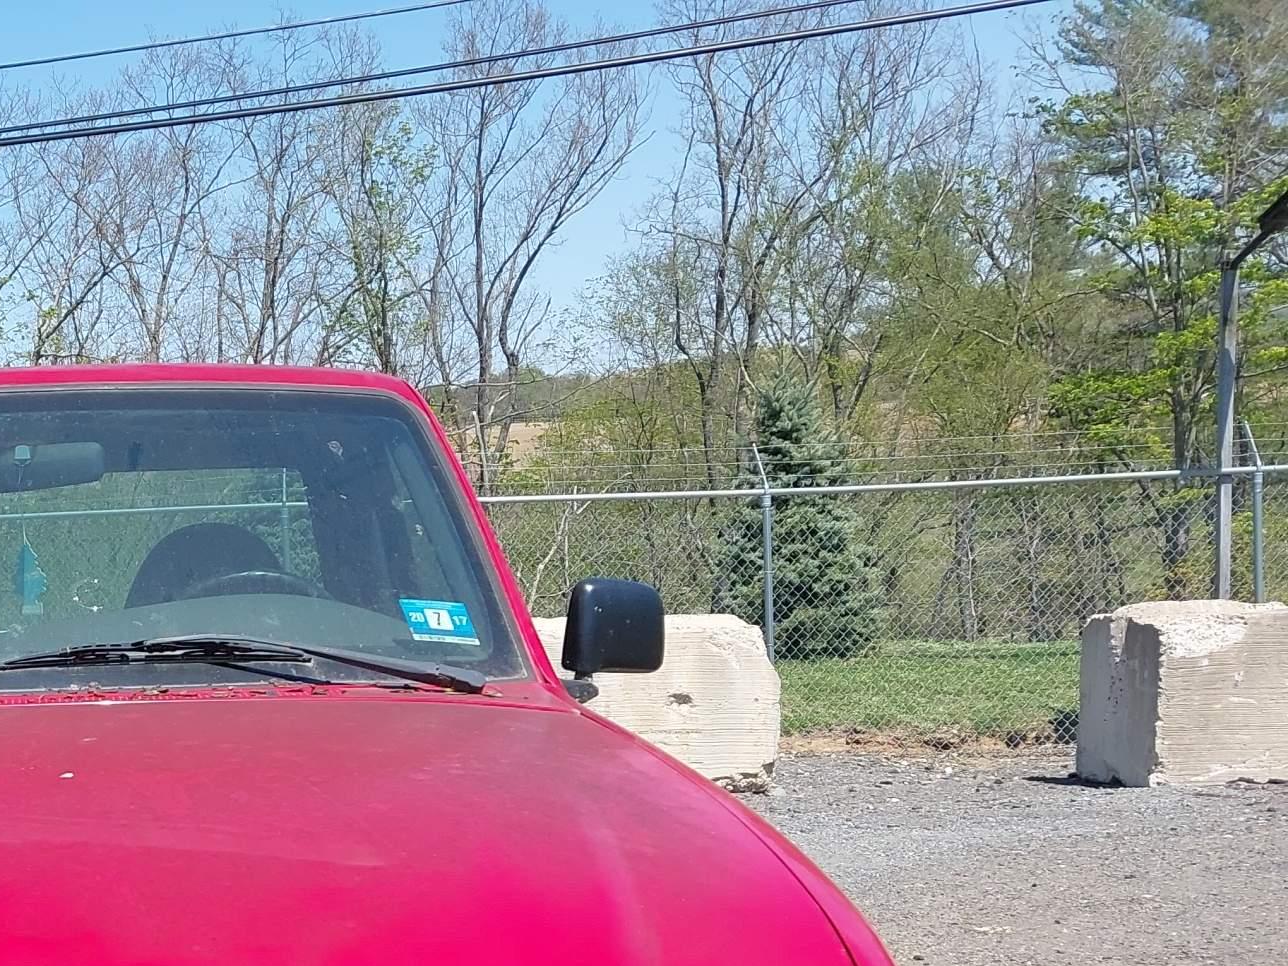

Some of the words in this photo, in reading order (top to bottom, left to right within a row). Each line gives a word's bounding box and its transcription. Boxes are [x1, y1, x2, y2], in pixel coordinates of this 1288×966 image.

[408, 611, 425, 623] 20
[432, 611, 442, 626] 7
[452, 615, 468, 626] 17
